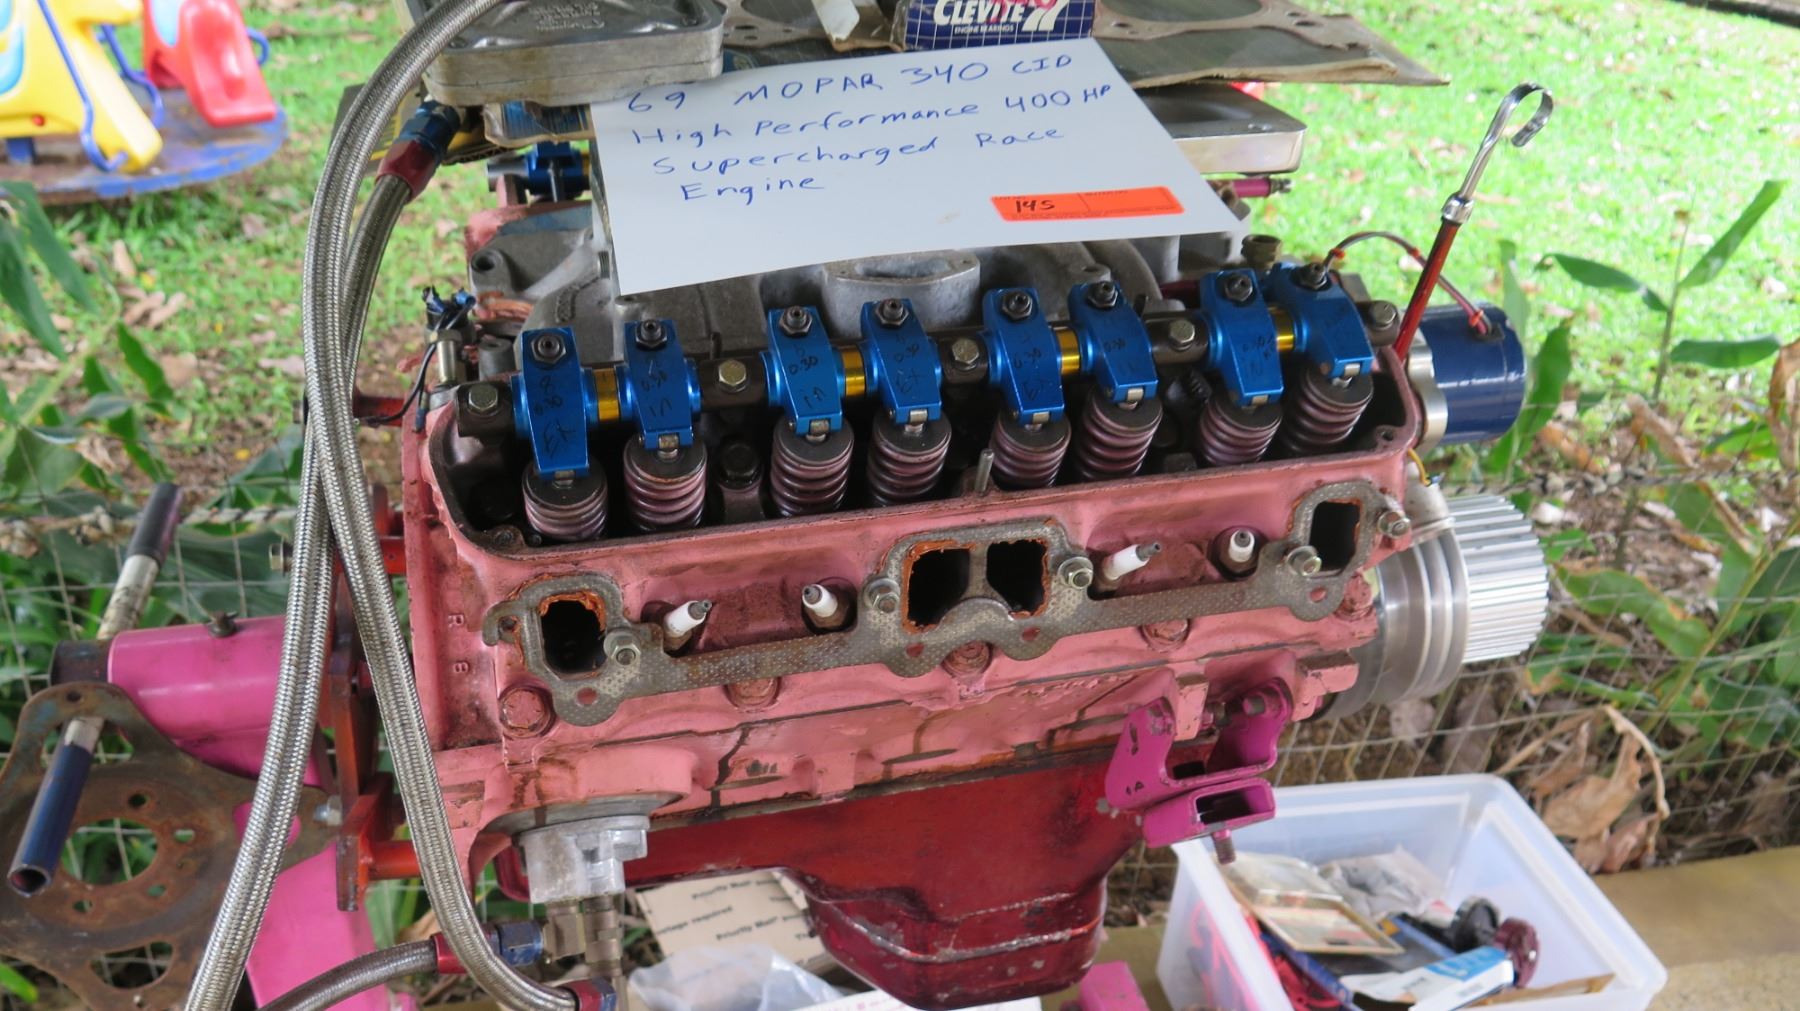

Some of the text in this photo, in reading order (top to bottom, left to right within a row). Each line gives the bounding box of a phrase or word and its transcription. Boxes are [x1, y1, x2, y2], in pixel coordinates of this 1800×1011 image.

[628, 54, 1072, 113] 69 MOPAR 340 CID
[632, 84, 1111, 148] High Performance 400 HP
[653, 128, 1065, 175] Supercharged Race
[680, 177, 825, 206] Engine
